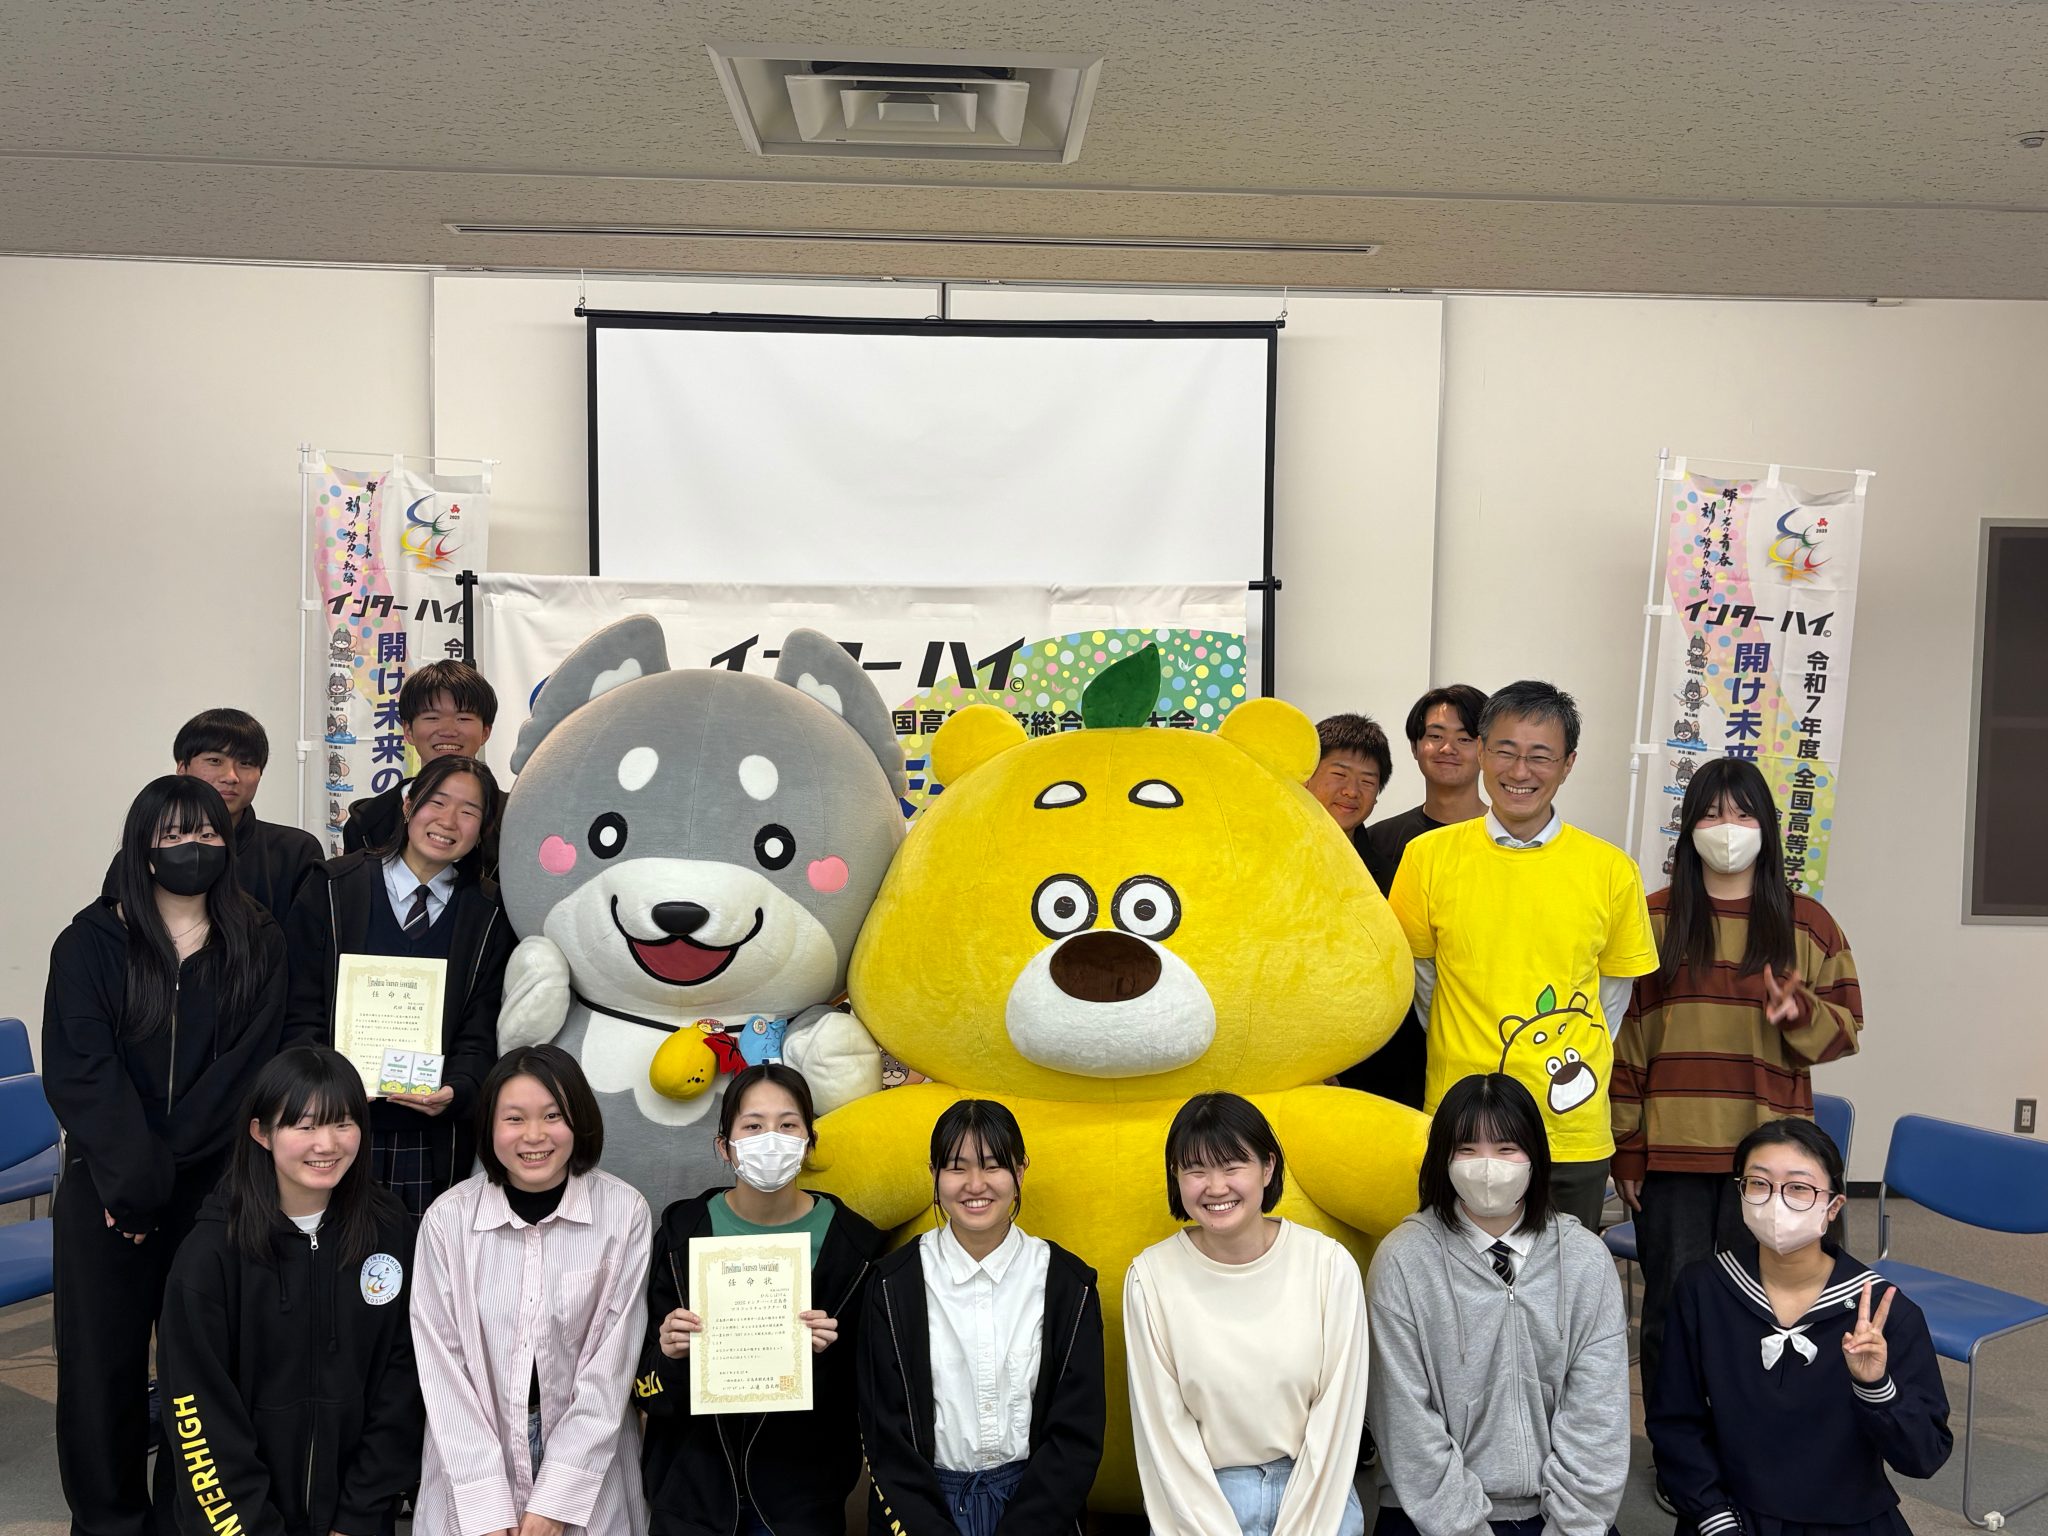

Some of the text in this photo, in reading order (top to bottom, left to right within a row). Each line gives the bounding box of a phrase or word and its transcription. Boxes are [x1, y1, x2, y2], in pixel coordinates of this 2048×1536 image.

[371, 631, 407, 794] 開け未来の
